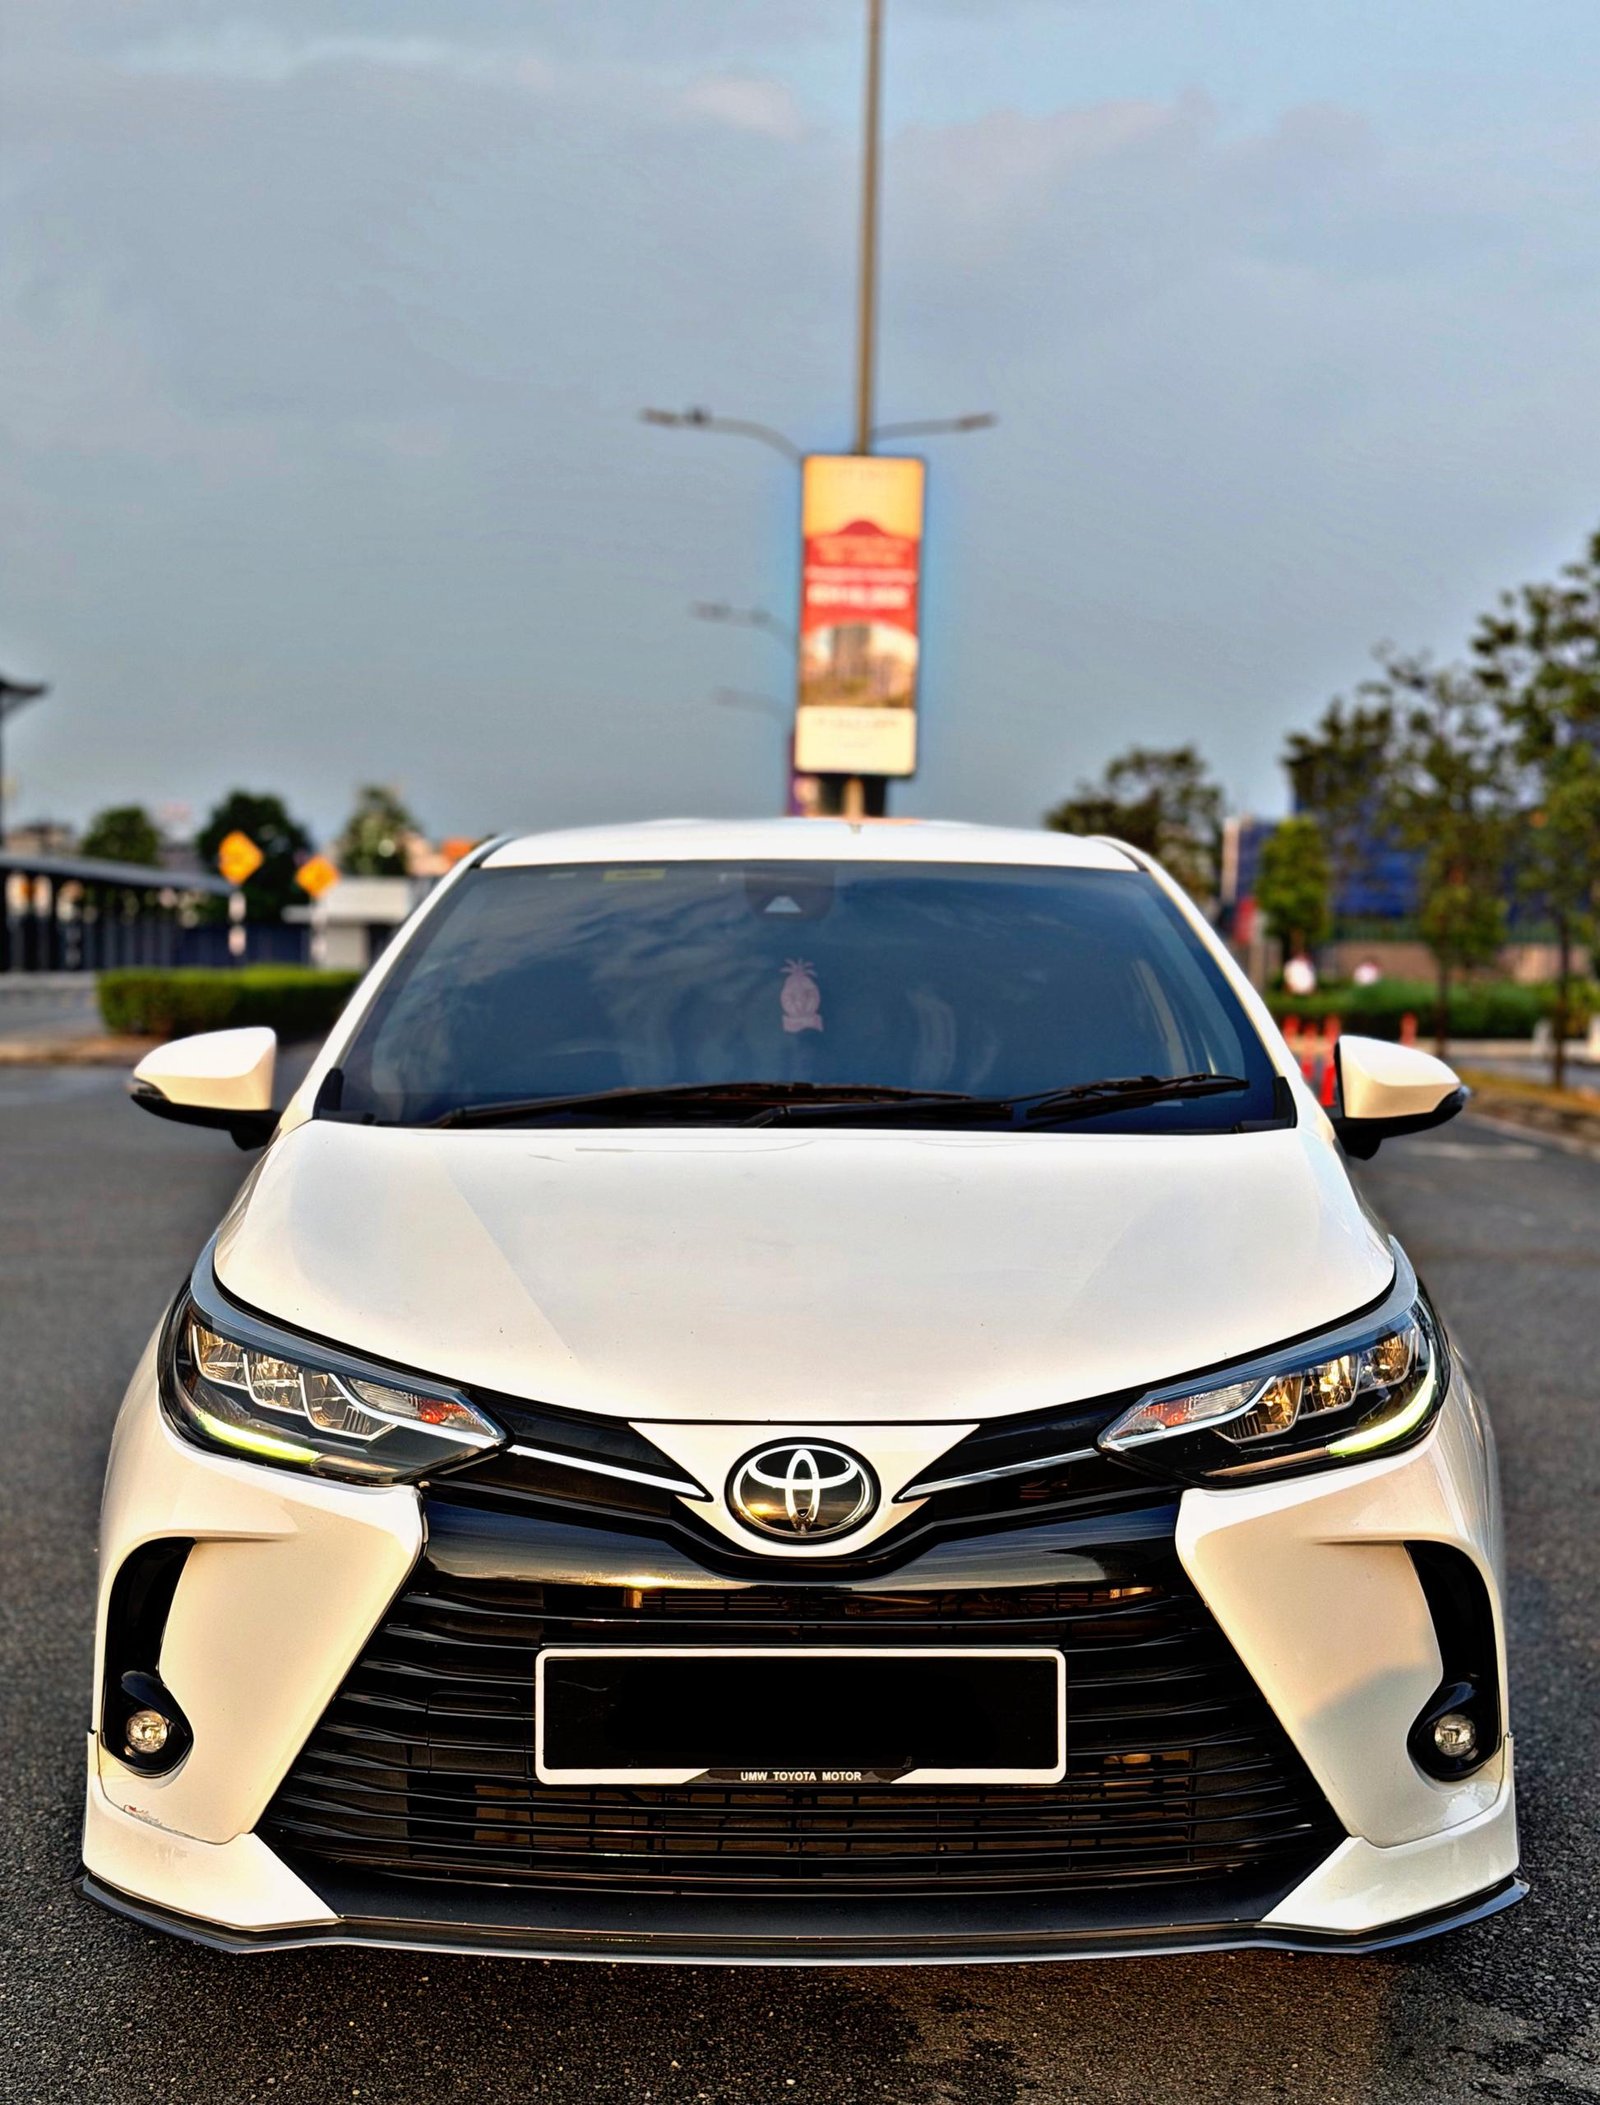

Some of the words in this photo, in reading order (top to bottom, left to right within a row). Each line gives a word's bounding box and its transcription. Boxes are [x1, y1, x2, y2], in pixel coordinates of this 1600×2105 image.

[740, 1771, 768, 1781] UMW
[773, 1771, 817, 1781] TOYOTA
[822, 1771, 862, 1781] MOTOR
